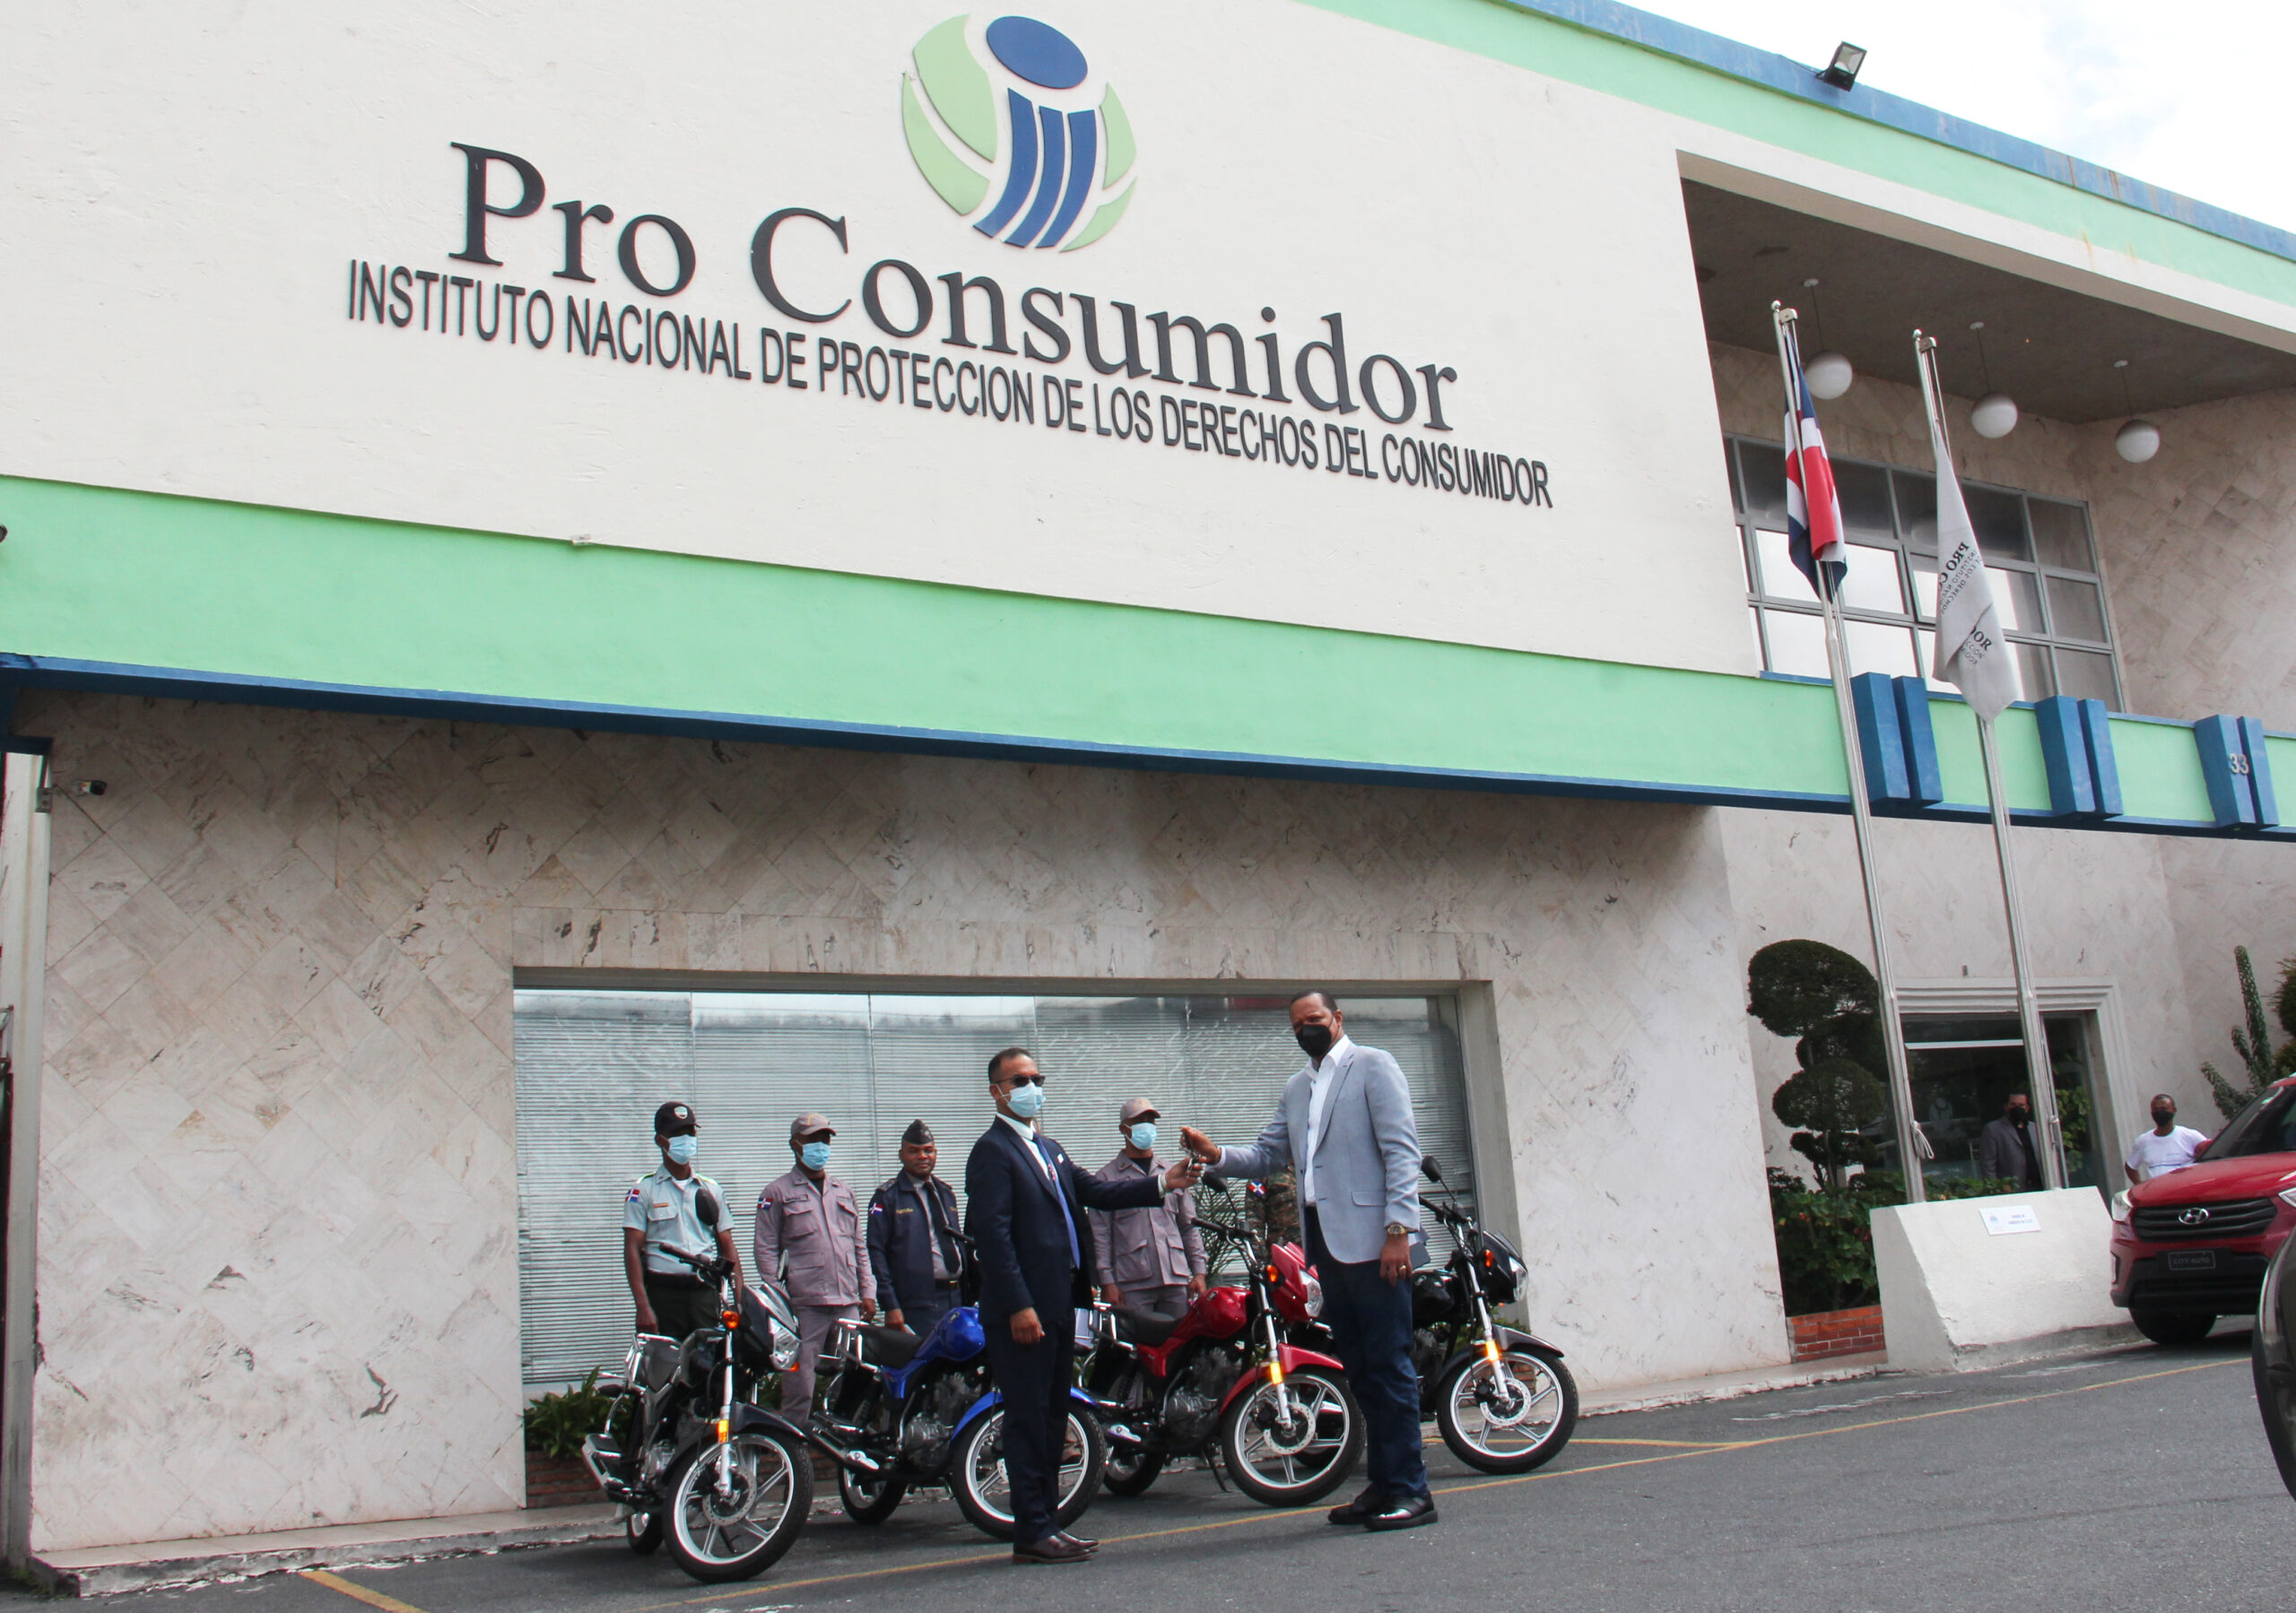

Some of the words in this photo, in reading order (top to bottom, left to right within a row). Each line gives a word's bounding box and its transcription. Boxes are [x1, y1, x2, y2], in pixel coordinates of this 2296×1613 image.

[348, 259, 554, 350] INSTITUTO
[567, 295, 752, 381] NACIONAL
[761, 327, 808, 389] DE
[818, 337, 1035, 425] PROTECCION
[1042, 375, 1087, 433] DE
[1092, 383, 1153, 443] LOS
[1160, 395, 1319, 471] DERECHOS
[1324, 422, 1378, 480] DEL
[1381, 433, 1553, 508] CONSUMIDOR
[448, 142, 696, 297] Pro
[751, 207, 1457, 432] Consumidor
[2229, 753, 2249, 775] 33
